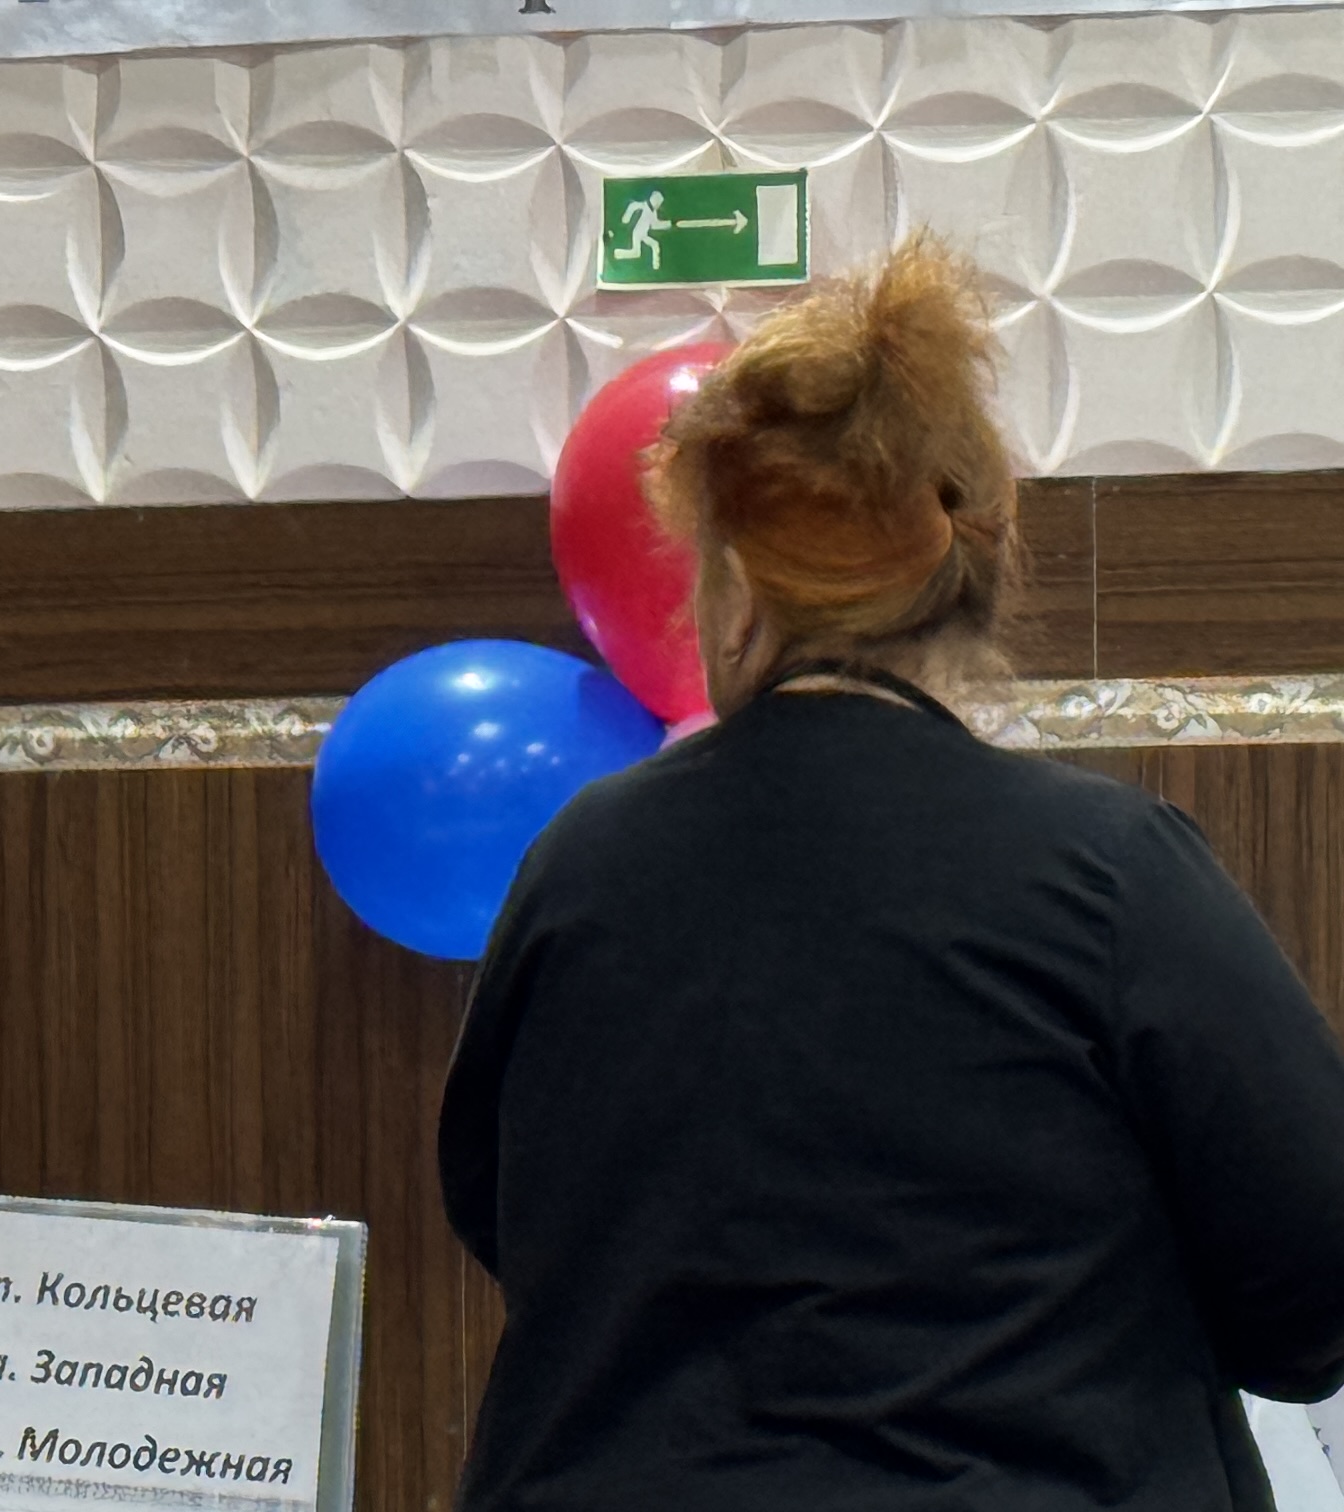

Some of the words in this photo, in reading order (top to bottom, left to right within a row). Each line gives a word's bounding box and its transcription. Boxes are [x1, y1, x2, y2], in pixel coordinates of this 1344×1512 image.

[36, 1270, 258, 1324] Кольцевая
[29, 1349, 228, 1400] Западная
[16, 1425, 294, 1485] Молодежная
